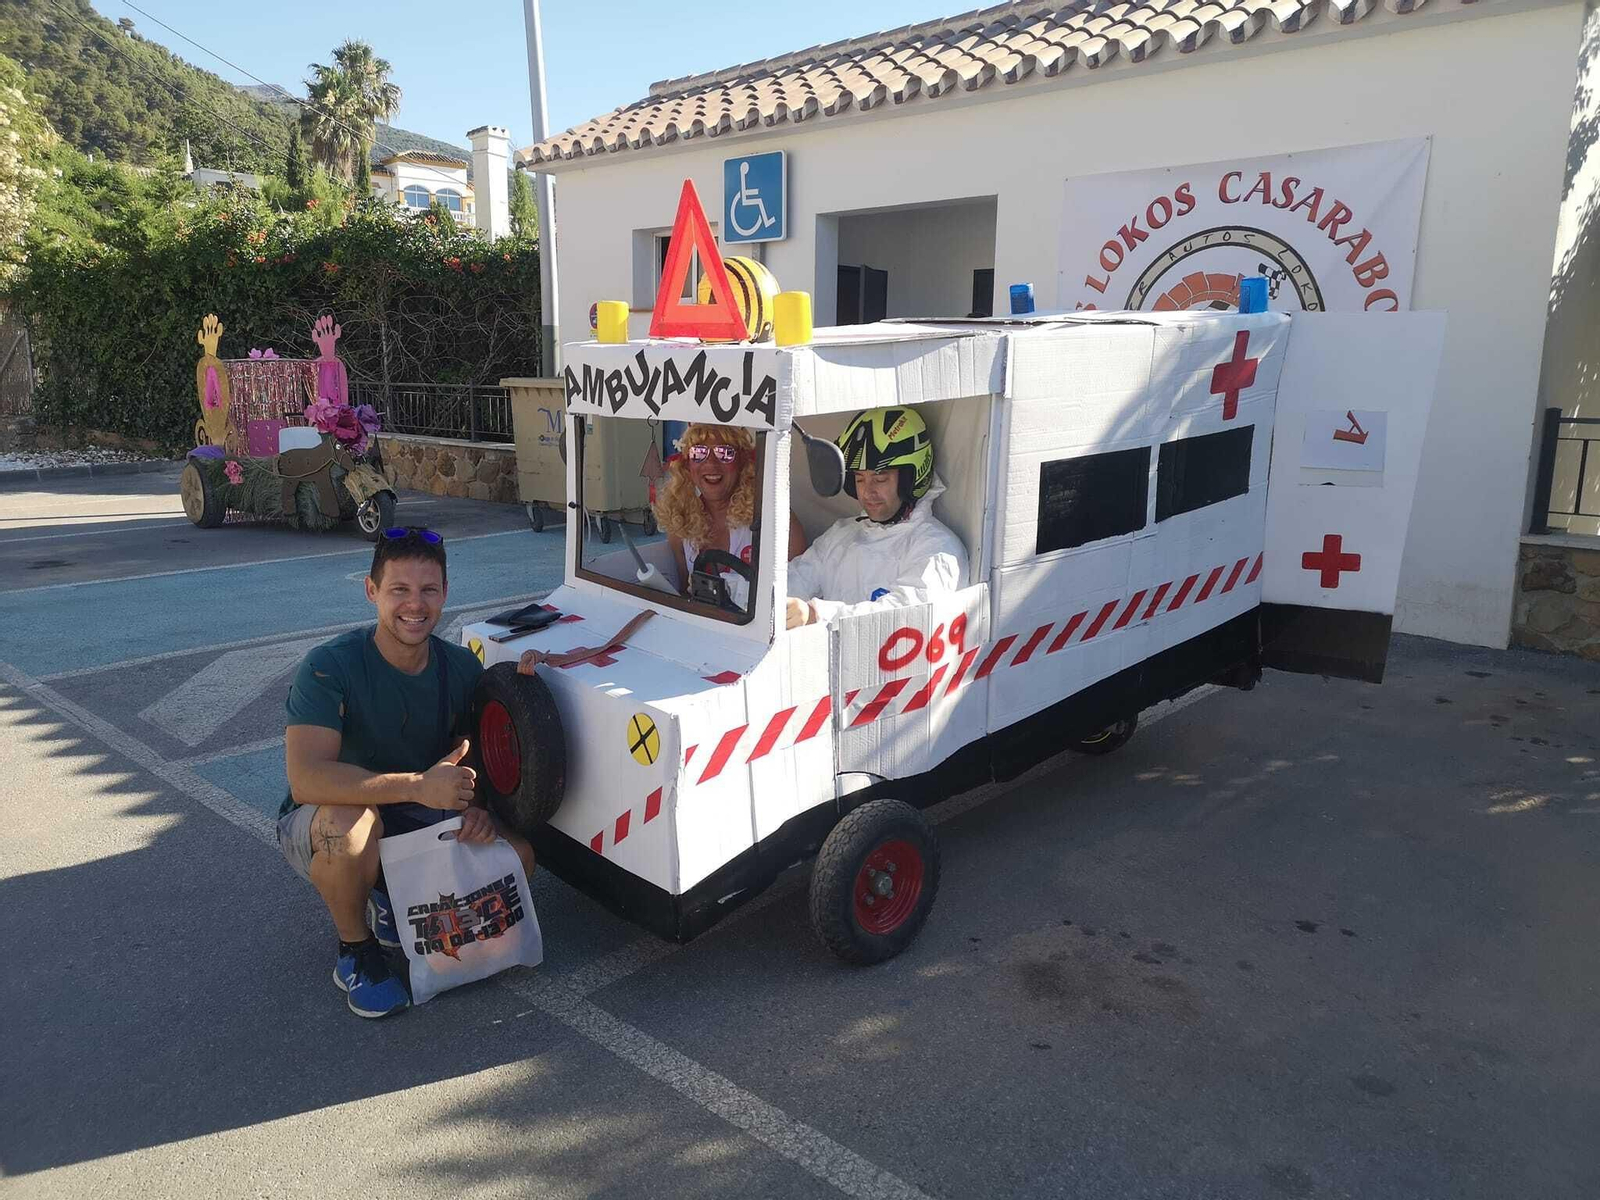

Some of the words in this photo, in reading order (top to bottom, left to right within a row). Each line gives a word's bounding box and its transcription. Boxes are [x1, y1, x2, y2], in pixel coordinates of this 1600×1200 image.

[1084, 182, 1197, 294] LOKOS
[1168, 231, 1256, 261] AUTOS
[564, 349, 777, 427] AMBULANCIA
[878, 612, 967, 672] 069
